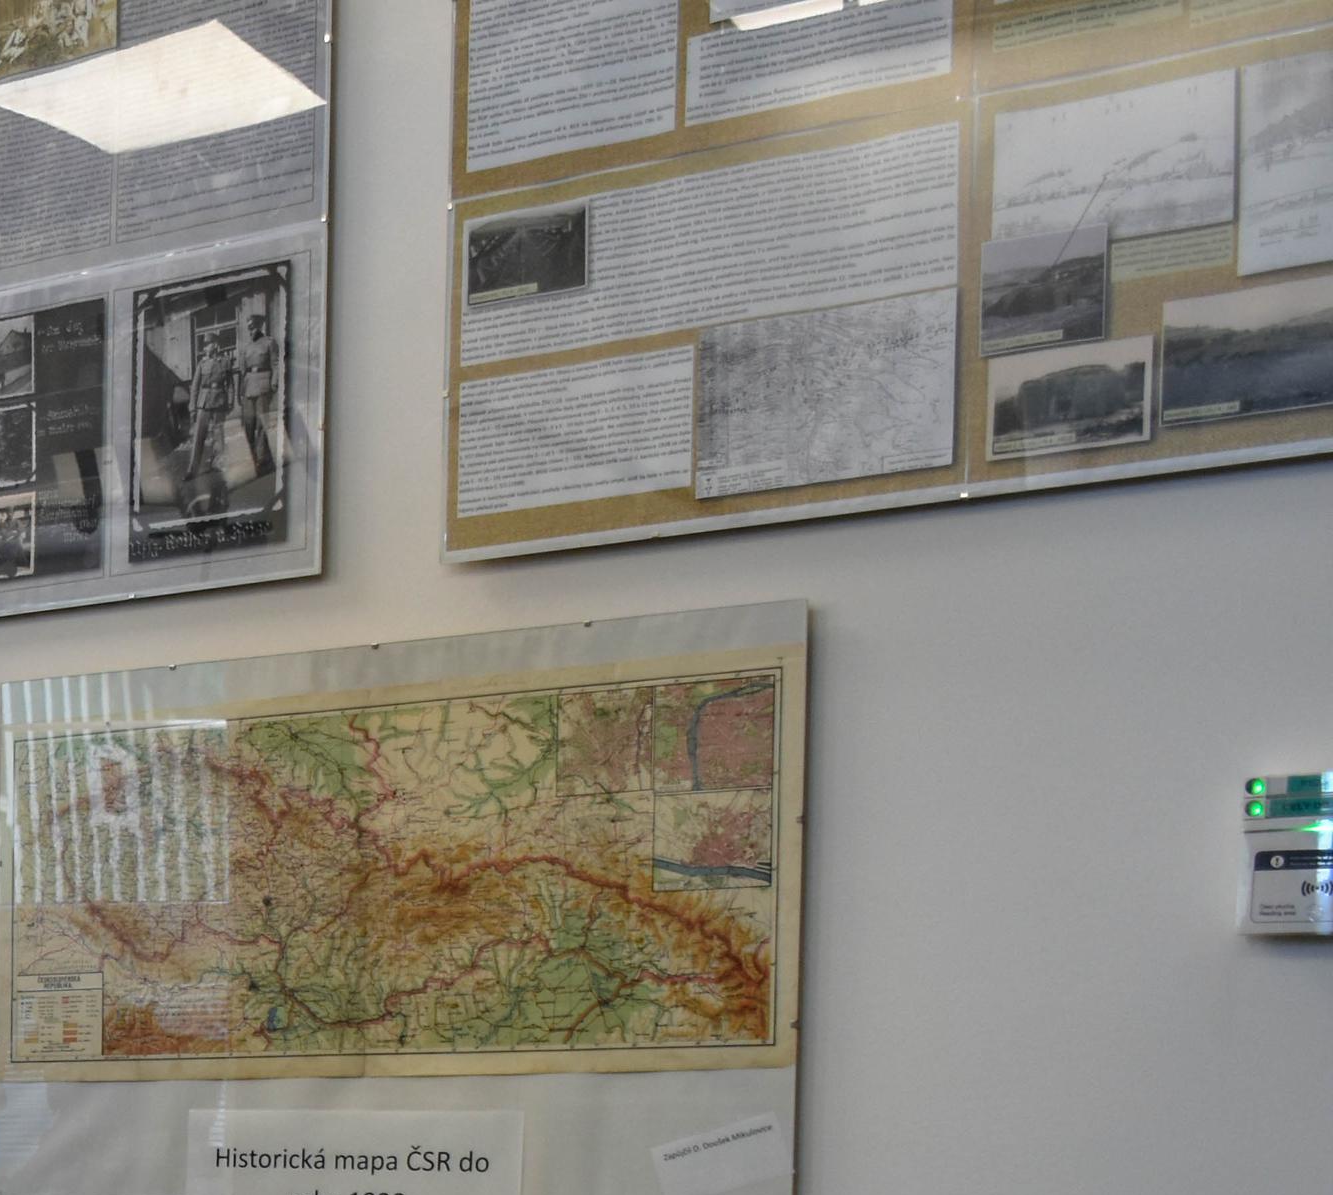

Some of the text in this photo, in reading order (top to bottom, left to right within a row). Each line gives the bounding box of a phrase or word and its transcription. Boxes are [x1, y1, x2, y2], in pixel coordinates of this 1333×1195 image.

[215, 1145, 490, 1176] Historická mapa ČSR do
